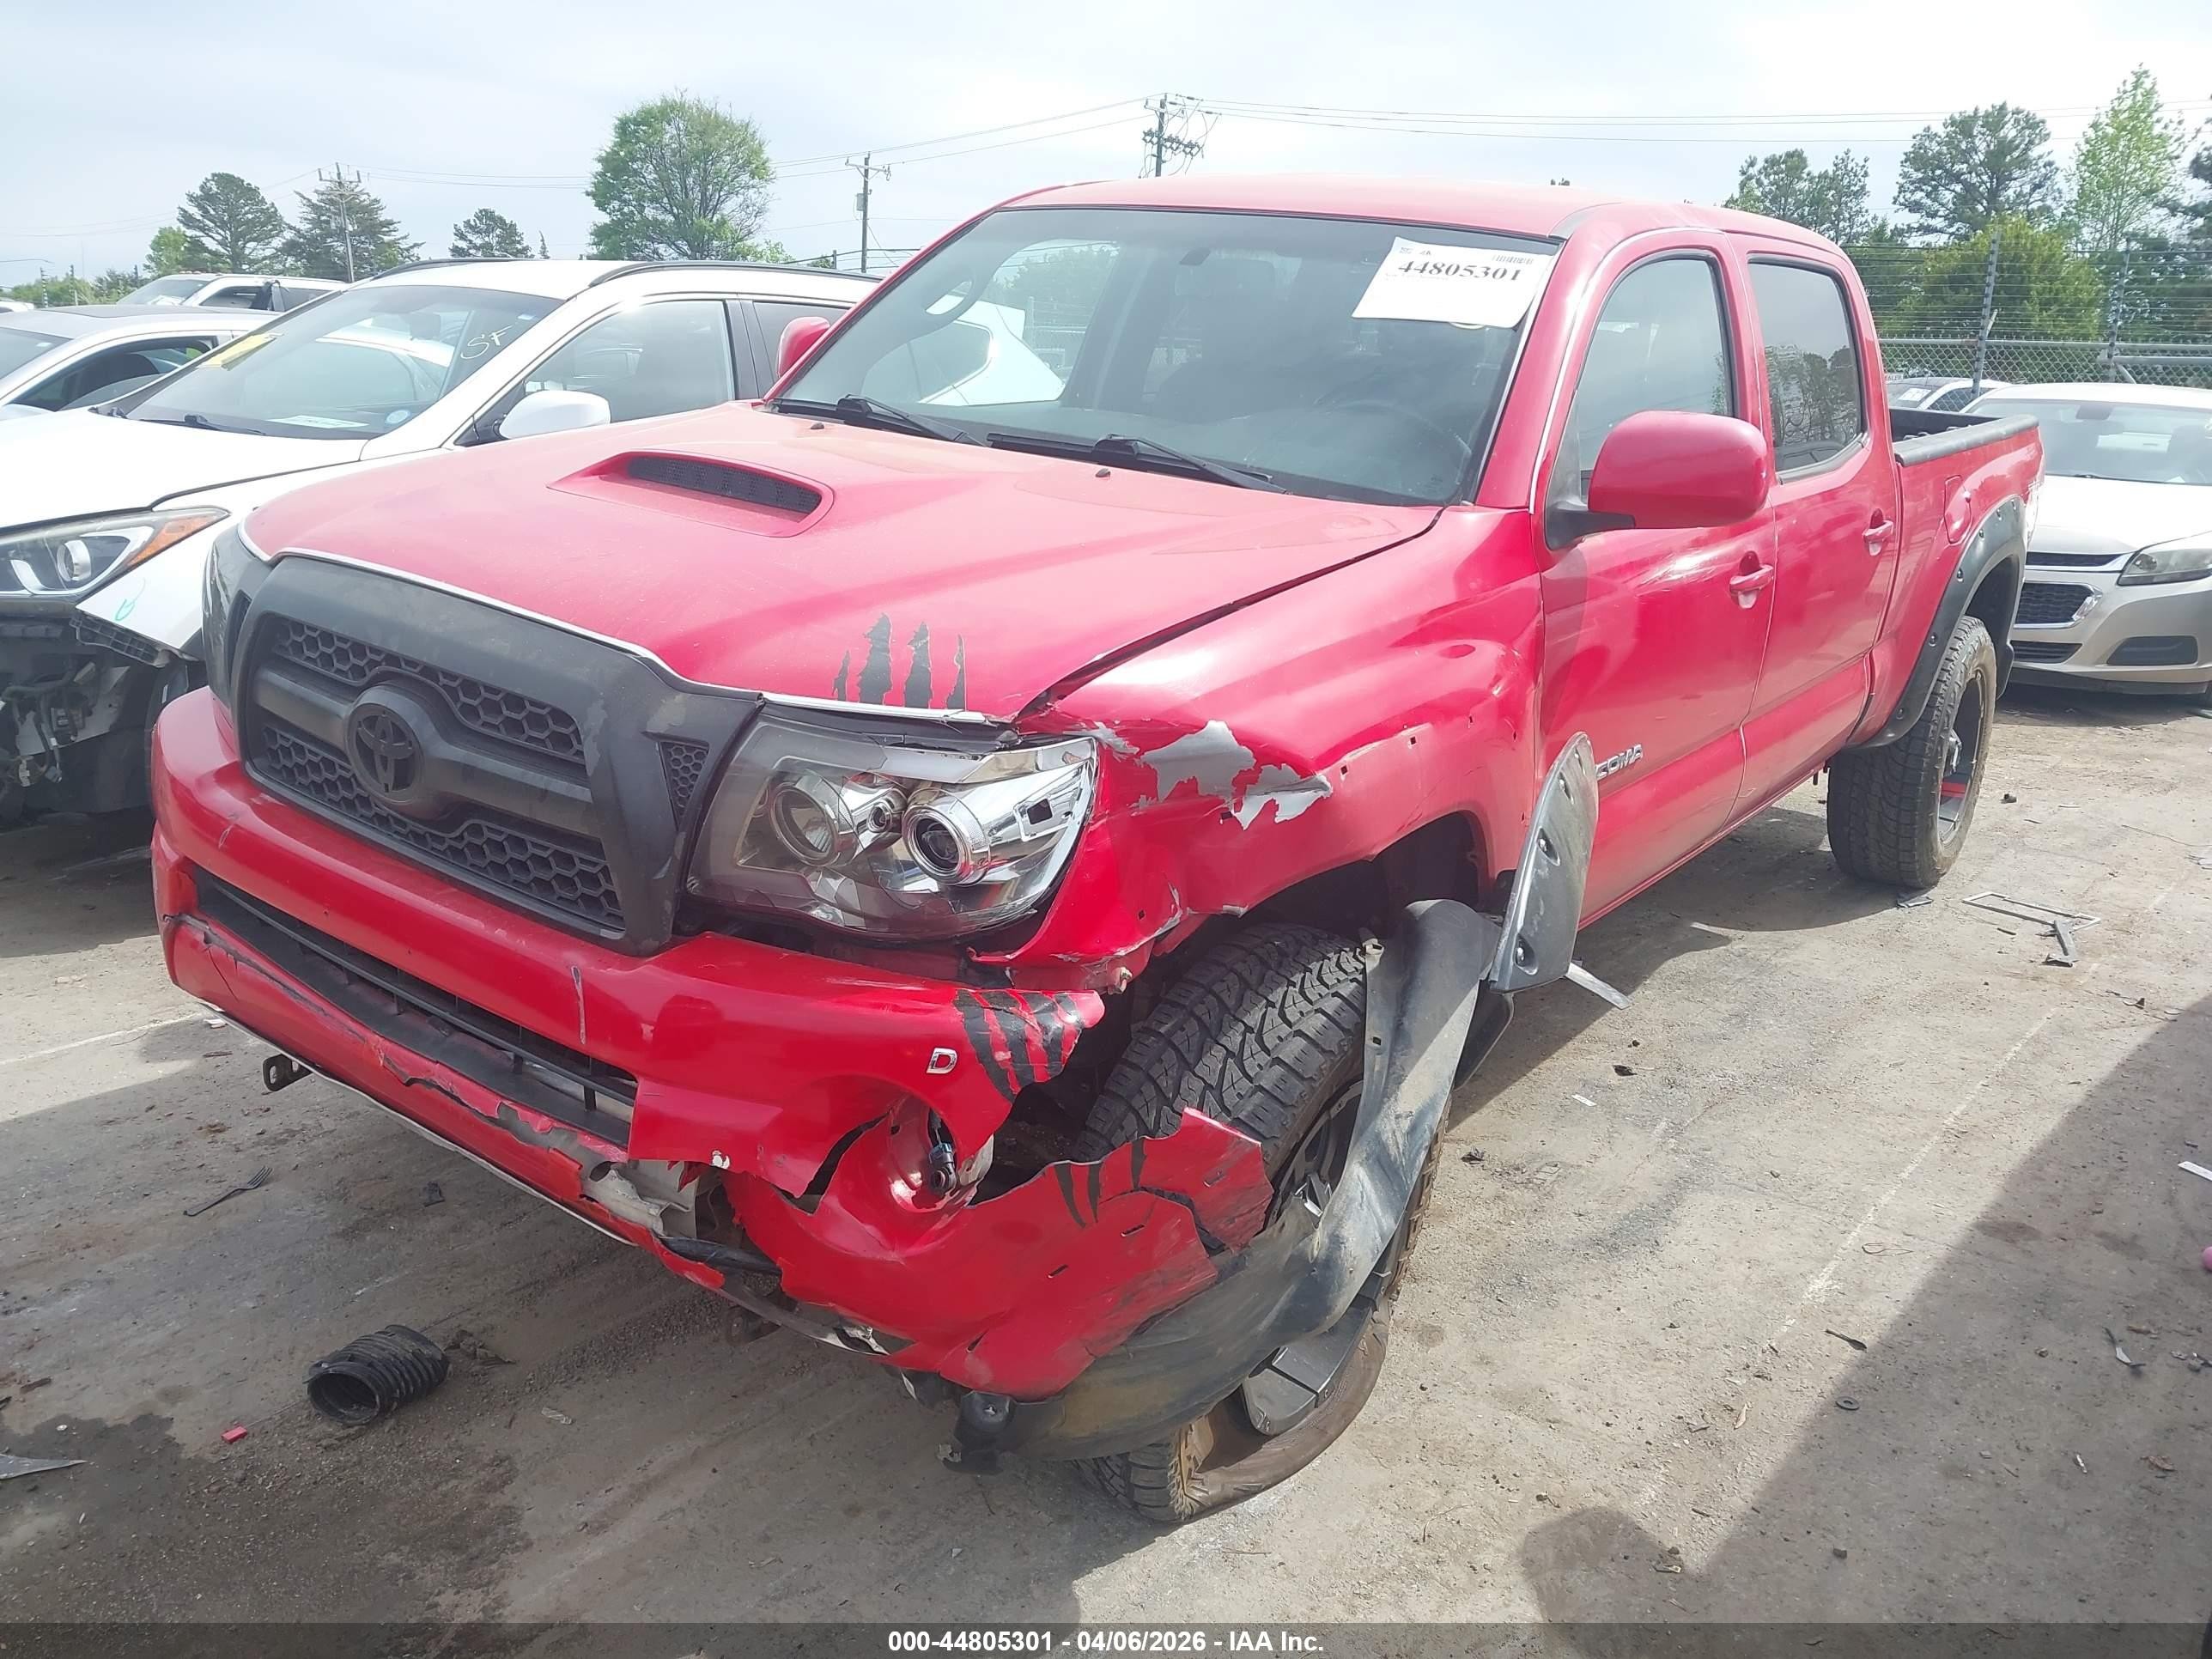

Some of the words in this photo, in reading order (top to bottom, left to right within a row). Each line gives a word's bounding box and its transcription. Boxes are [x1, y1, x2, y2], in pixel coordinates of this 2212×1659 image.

[1397, 260, 1522, 281] 44805301
[1595, 744, 1644, 781] COMA
[926, 1047, 958, 1074] D
